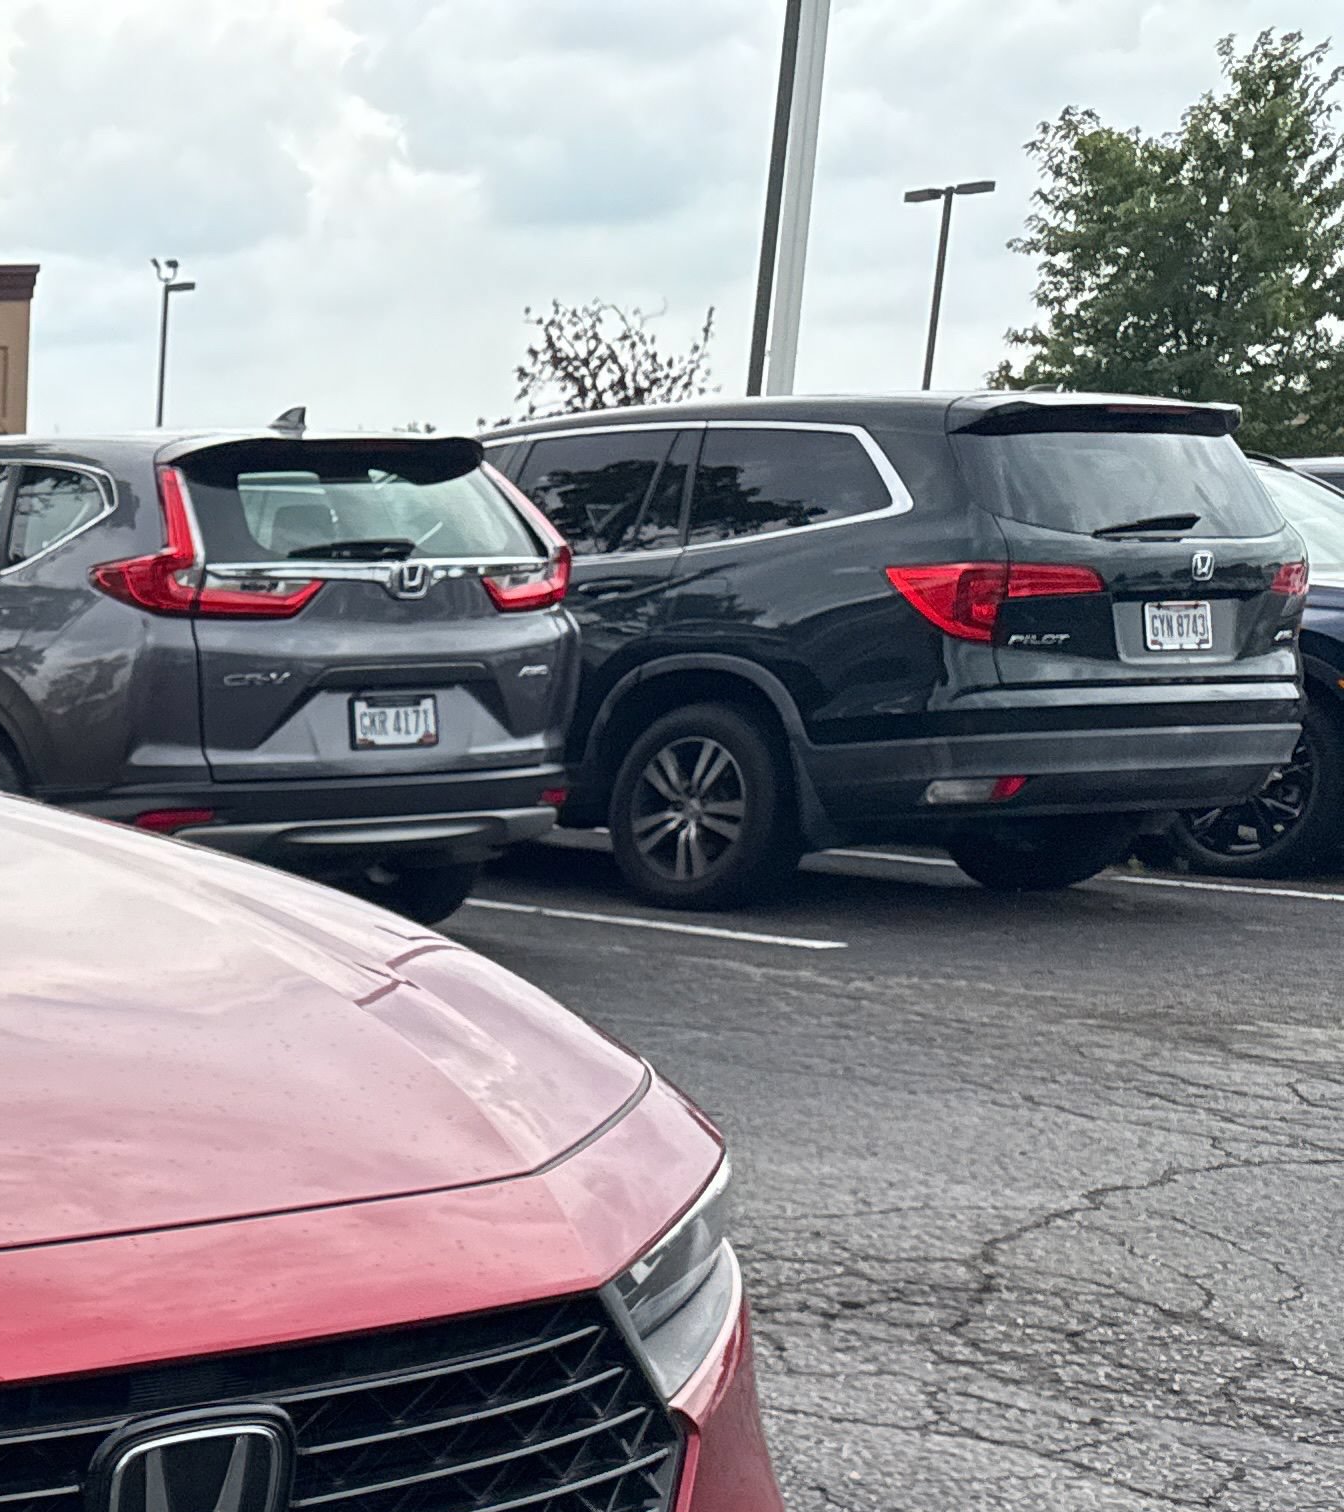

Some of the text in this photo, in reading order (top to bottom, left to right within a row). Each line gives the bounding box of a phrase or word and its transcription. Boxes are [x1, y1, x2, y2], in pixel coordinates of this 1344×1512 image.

[1151, 613, 1206, 638] GYN 8743
[1007, 633, 1071, 645] PILOT
